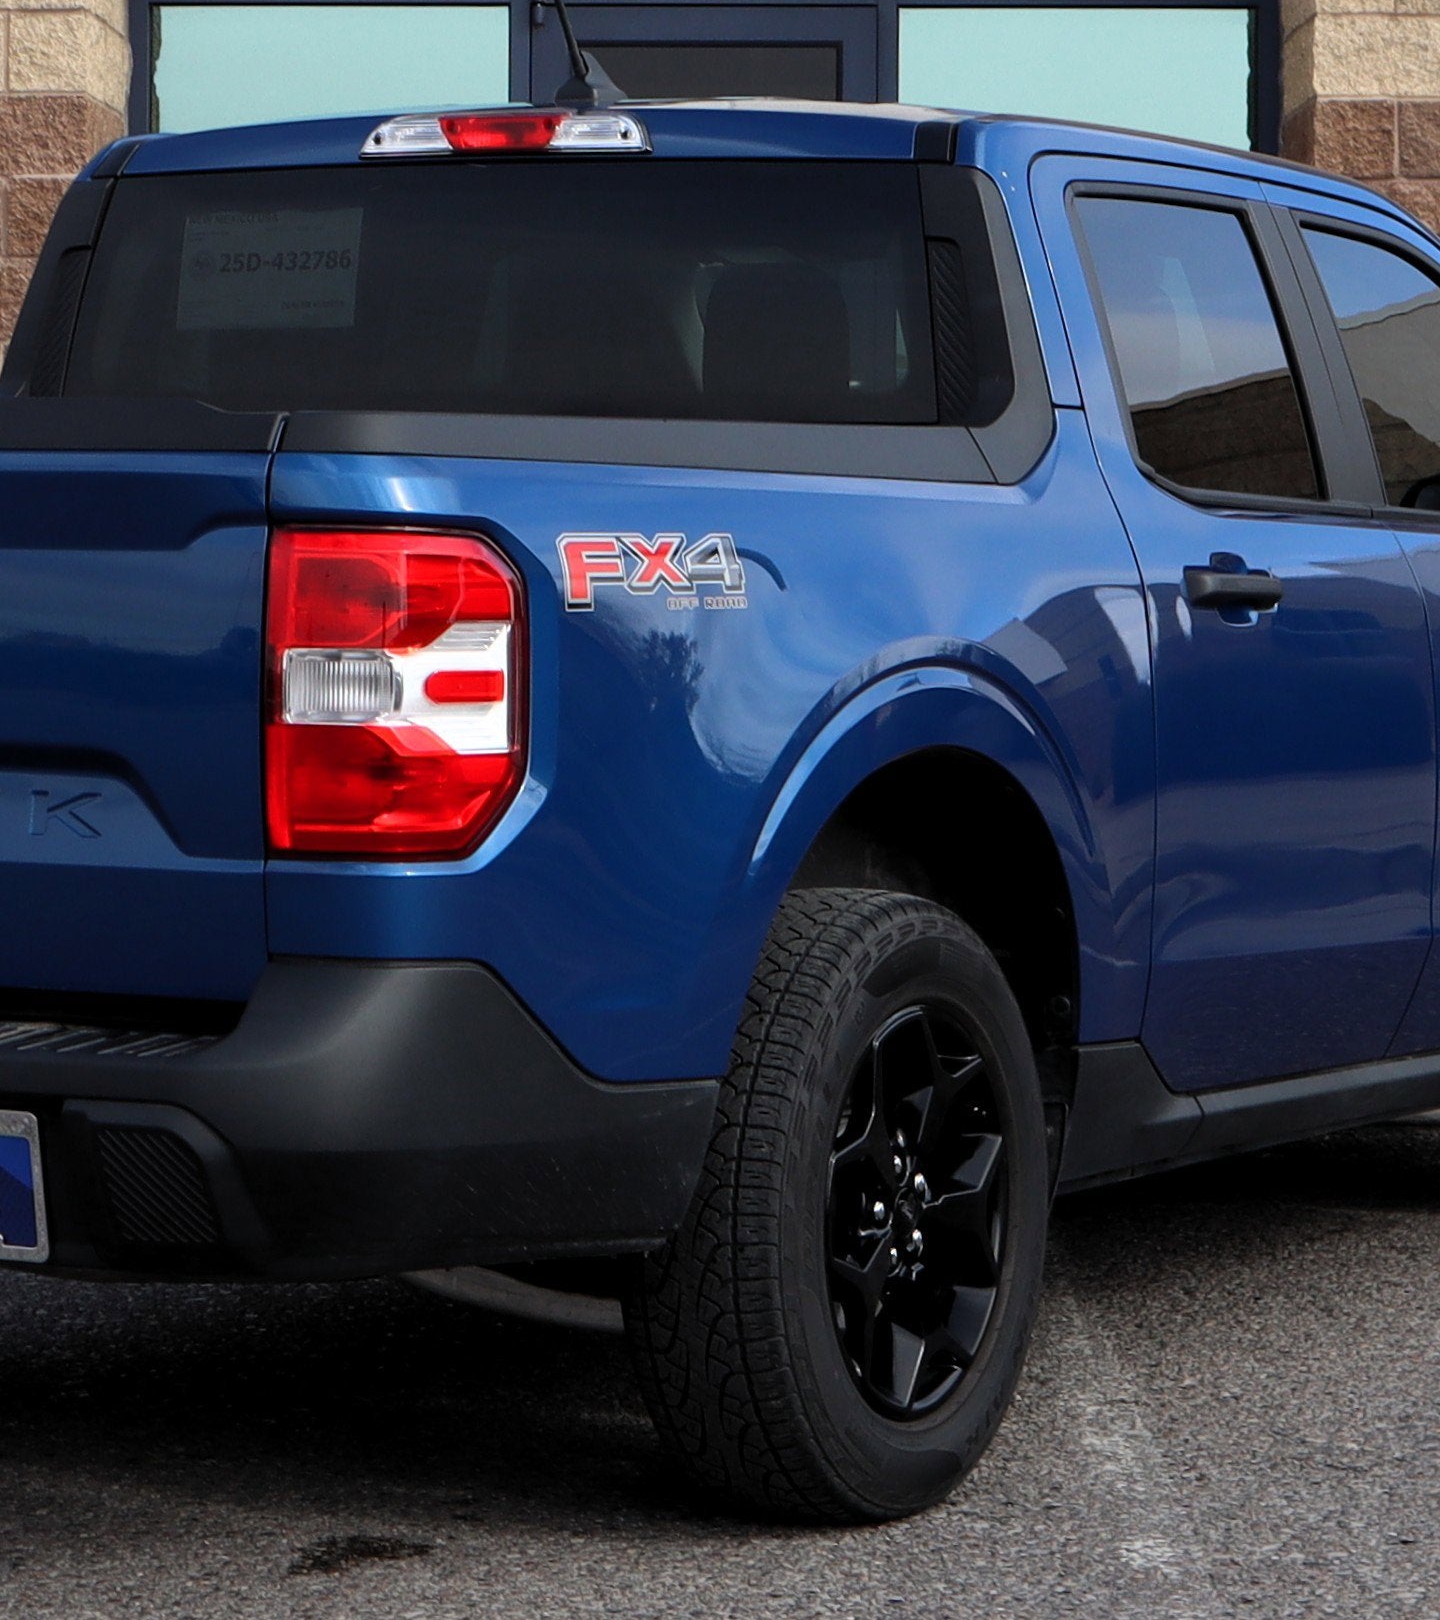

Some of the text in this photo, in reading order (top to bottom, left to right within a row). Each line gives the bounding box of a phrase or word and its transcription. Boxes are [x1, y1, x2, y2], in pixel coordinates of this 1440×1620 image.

[219, 248, 352, 273] 25D-432786
[556, 533, 745, 612] FX4
[667, 596, 748, 610] OFF ROAD
